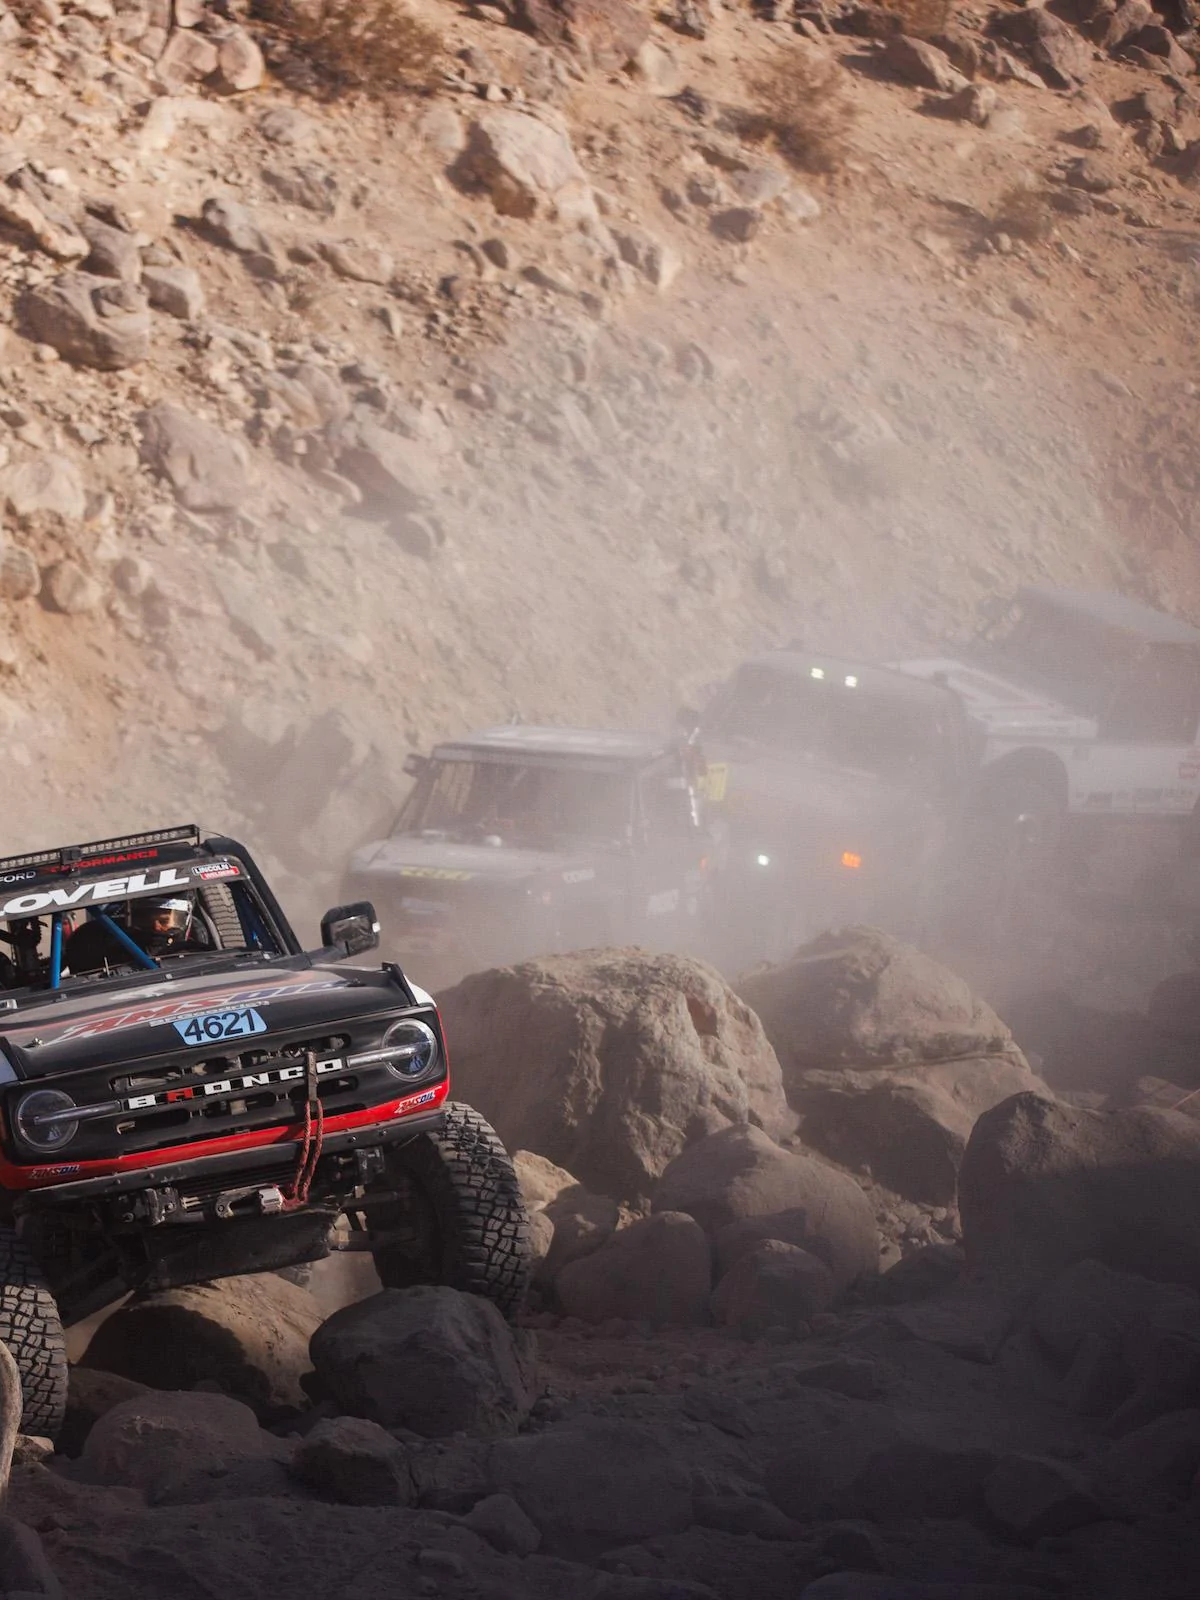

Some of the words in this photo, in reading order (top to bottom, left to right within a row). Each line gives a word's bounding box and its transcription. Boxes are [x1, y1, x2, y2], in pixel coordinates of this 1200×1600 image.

[194, 862, 231, 875] LINCOLN
[52, 980, 348, 1042] AMSOIL
[184, 1009, 257, 1042] 4621
[128, 1058, 343, 1110] BRONCO
[394, 1086, 442, 1114] AMSOIL
[28, 1165, 80, 1180] AMSOIL
